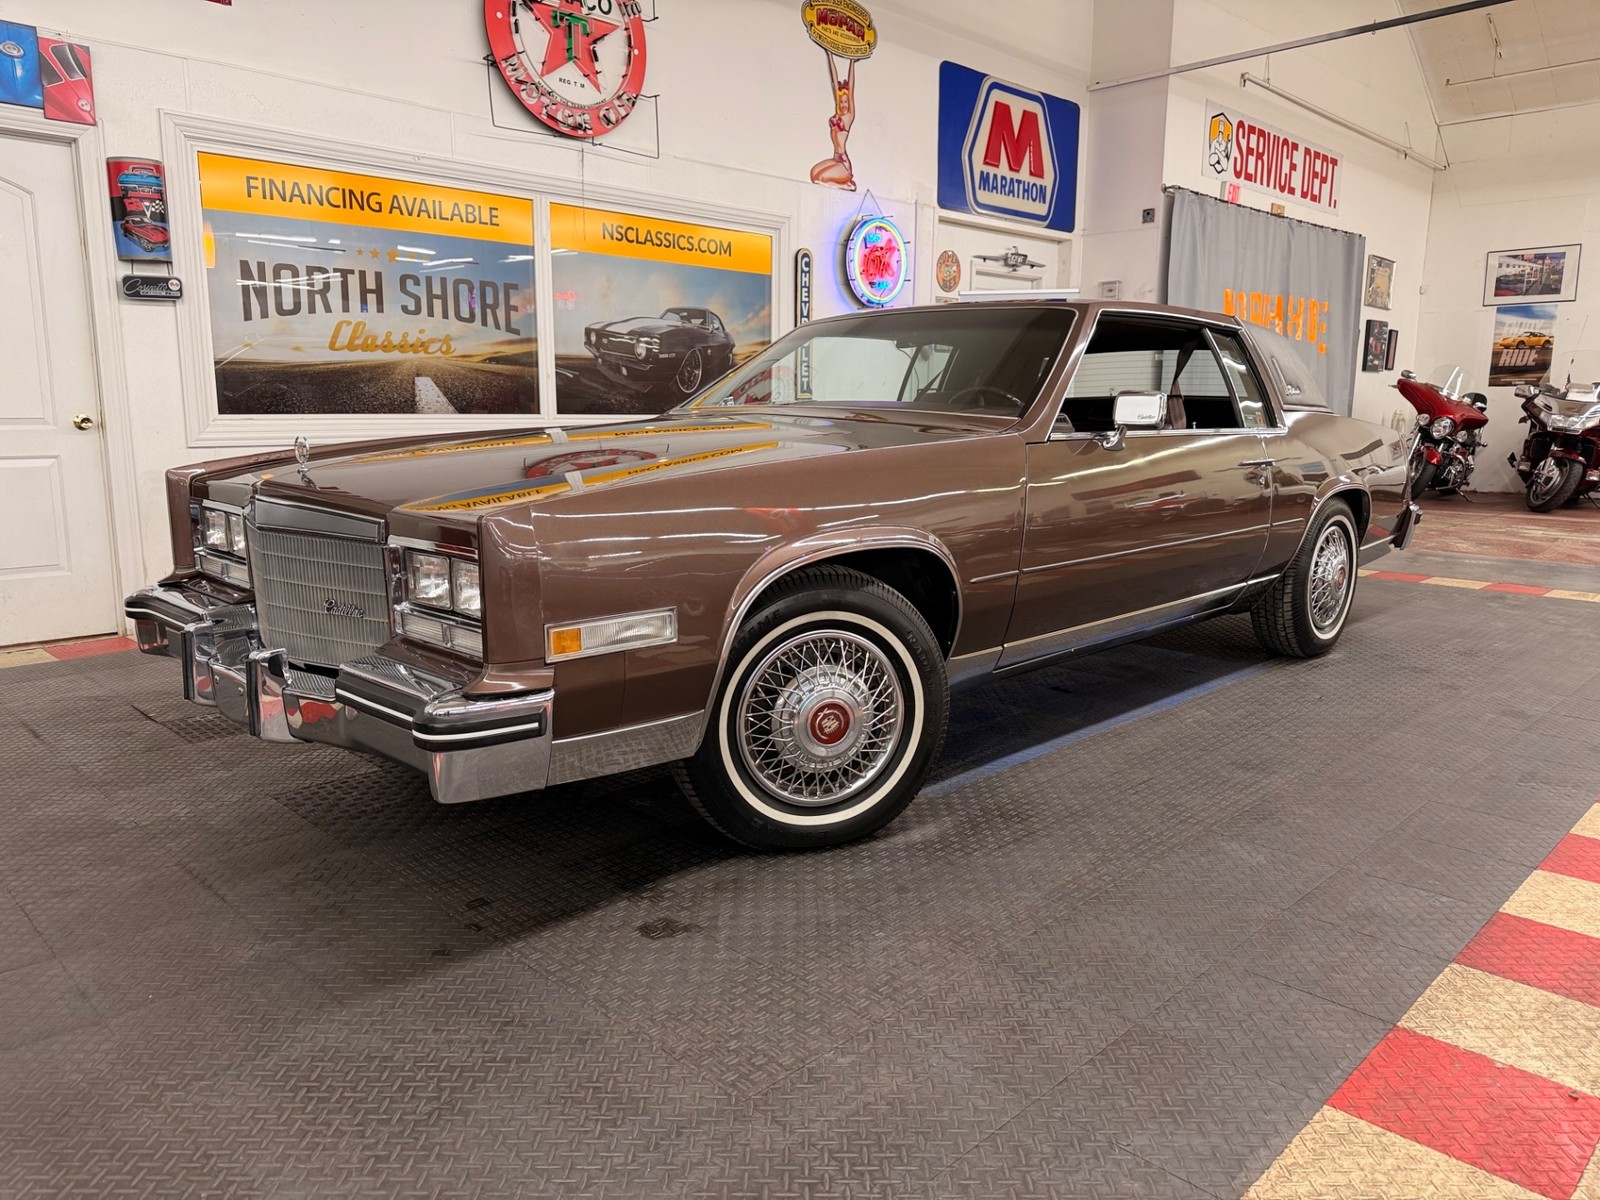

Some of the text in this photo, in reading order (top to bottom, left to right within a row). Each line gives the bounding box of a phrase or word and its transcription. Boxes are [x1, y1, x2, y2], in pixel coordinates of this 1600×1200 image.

[816, 8, 866, 42] MOPAR
[1233, 119, 1338, 209] SERVICE DEPT.
[245, 175, 500, 228] FINANCING AVAILABLE
[979, 170, 1047, 204] MARATHON
[601, 222, 733, 257] NSCLASSICS.COM
[239, 259, 521, 336] NORTH SHORE
[328, 320, 457, 356] Classics
[801, 256, 810, 391] CHEVLET
[1498, 348, 1538, 367] RIDE
[324, 598, 364, 618] Cadillac
